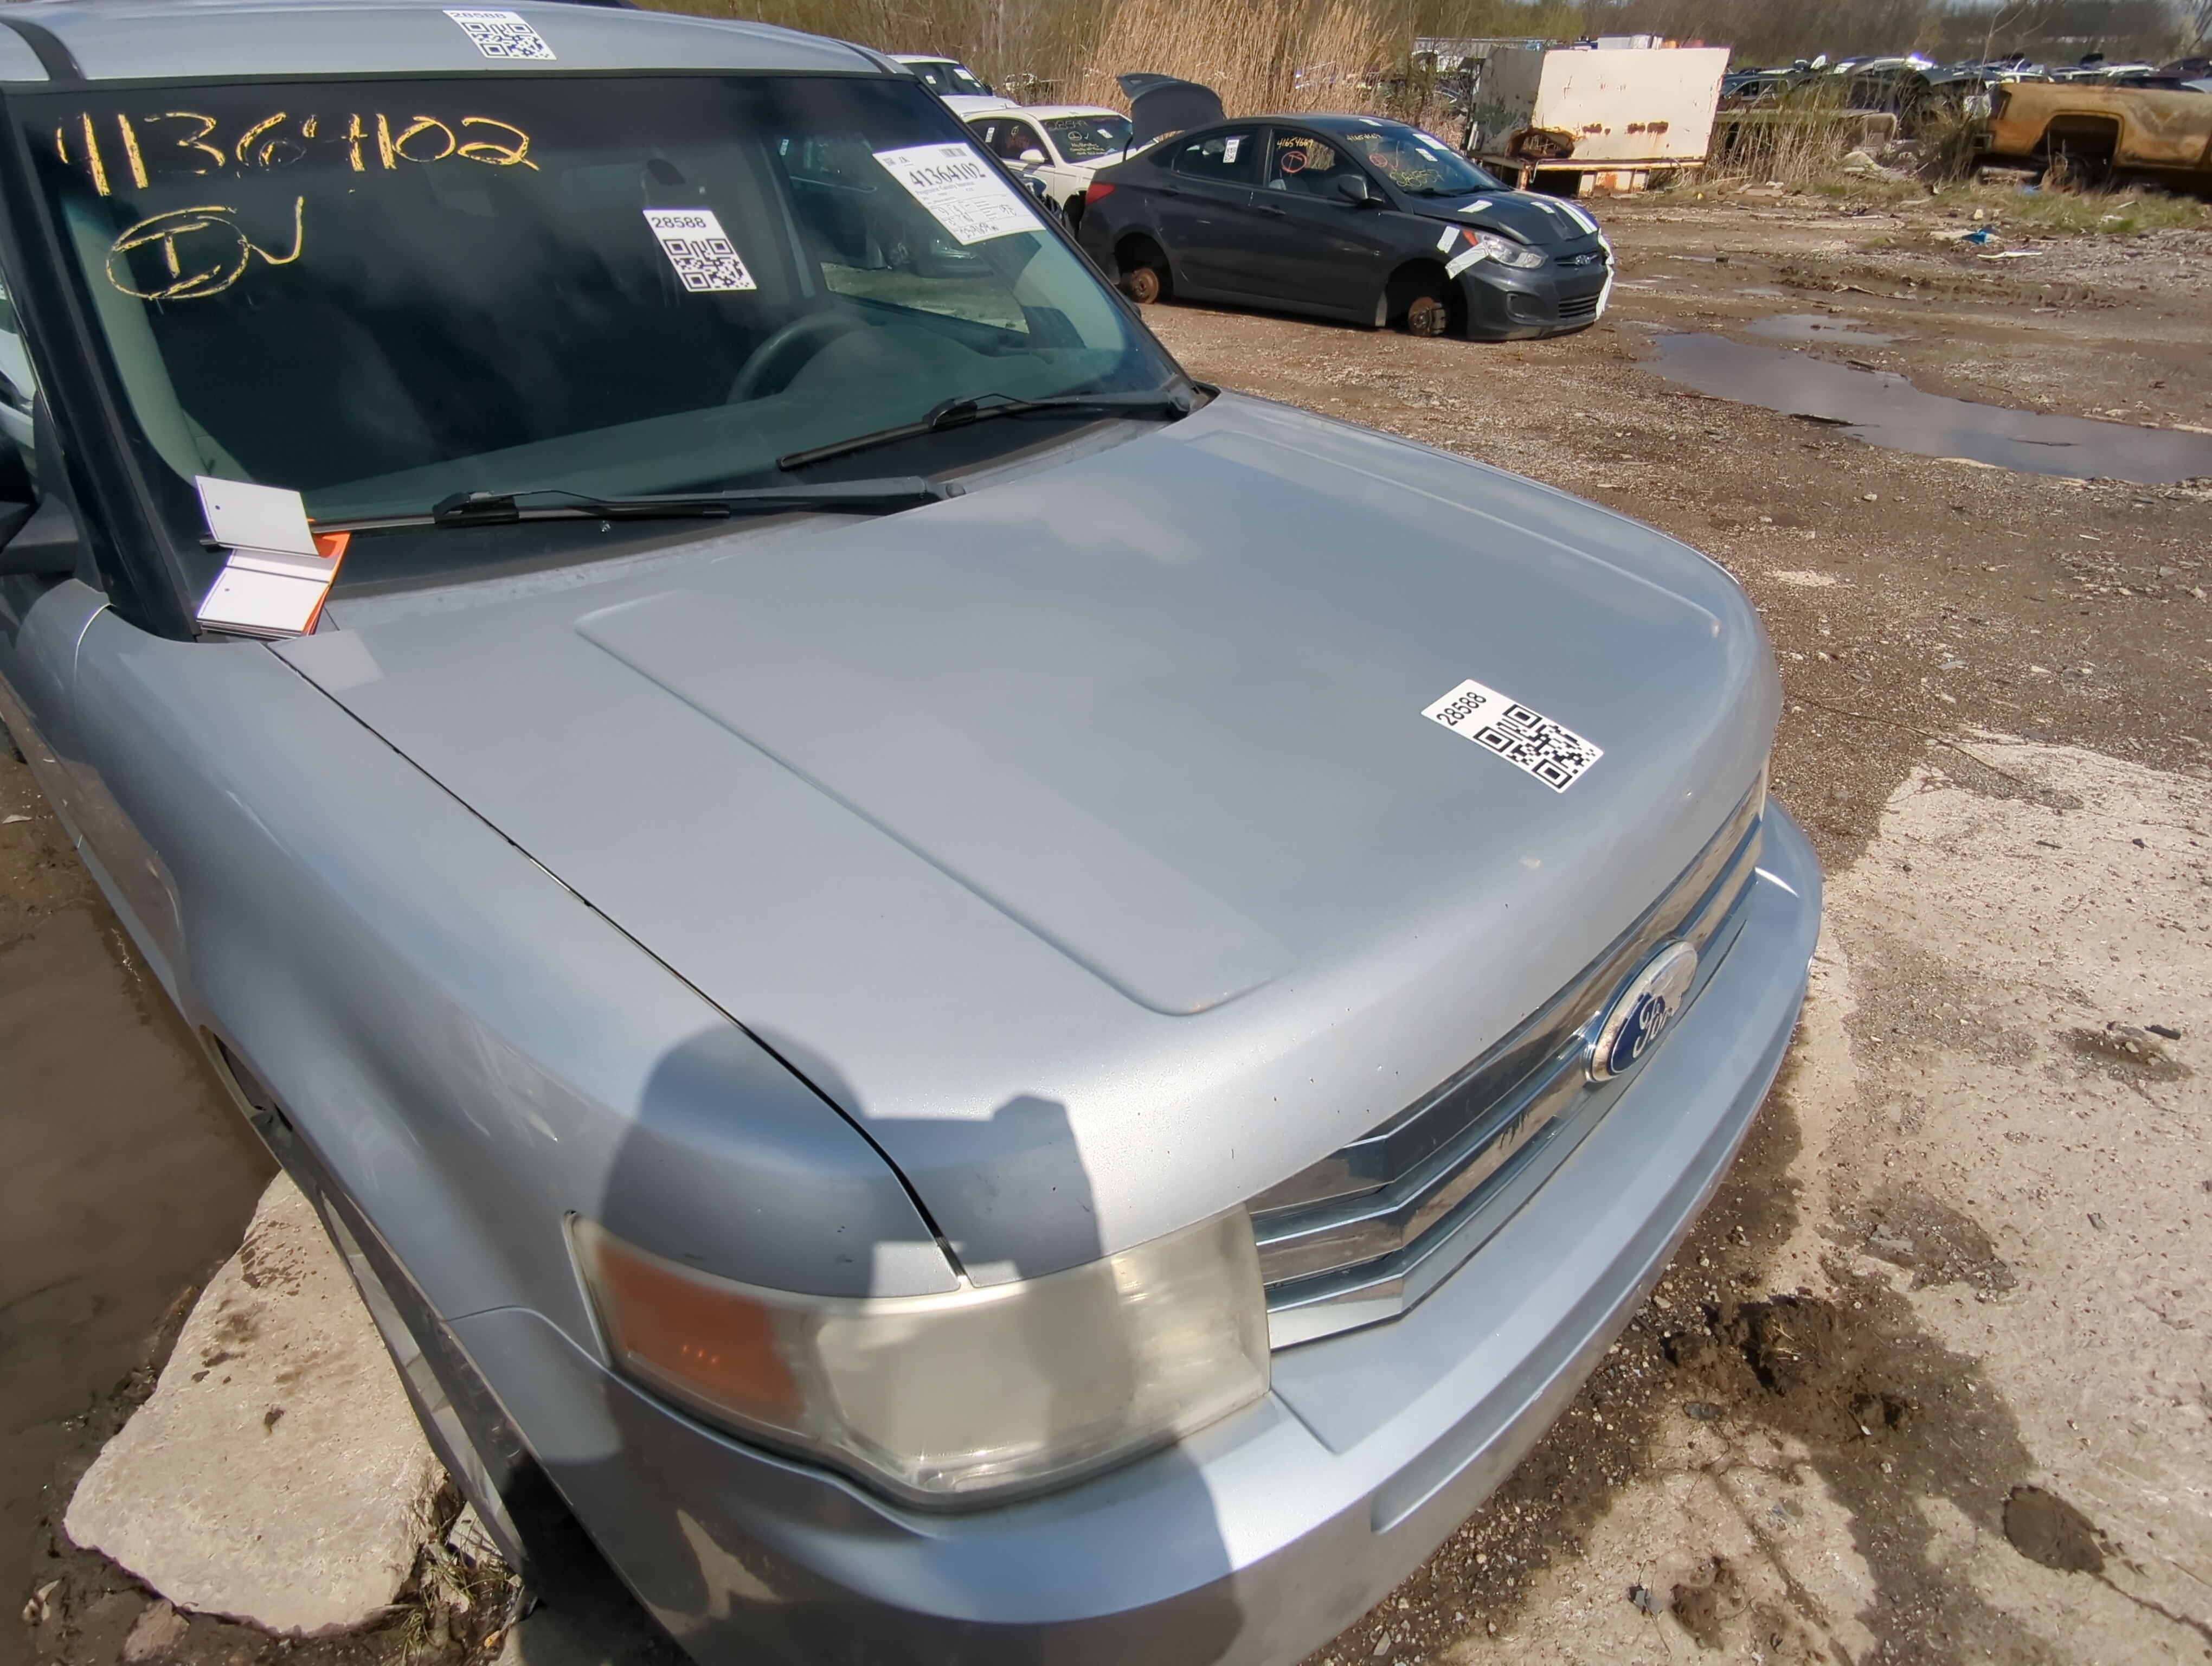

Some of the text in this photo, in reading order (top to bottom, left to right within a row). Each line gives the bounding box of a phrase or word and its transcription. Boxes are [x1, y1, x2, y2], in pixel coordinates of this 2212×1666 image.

[909, 163, 987, 187] 41364102
[651, 217, 707, 228] 28588
[1436, 691, 1487, 726] 28588
